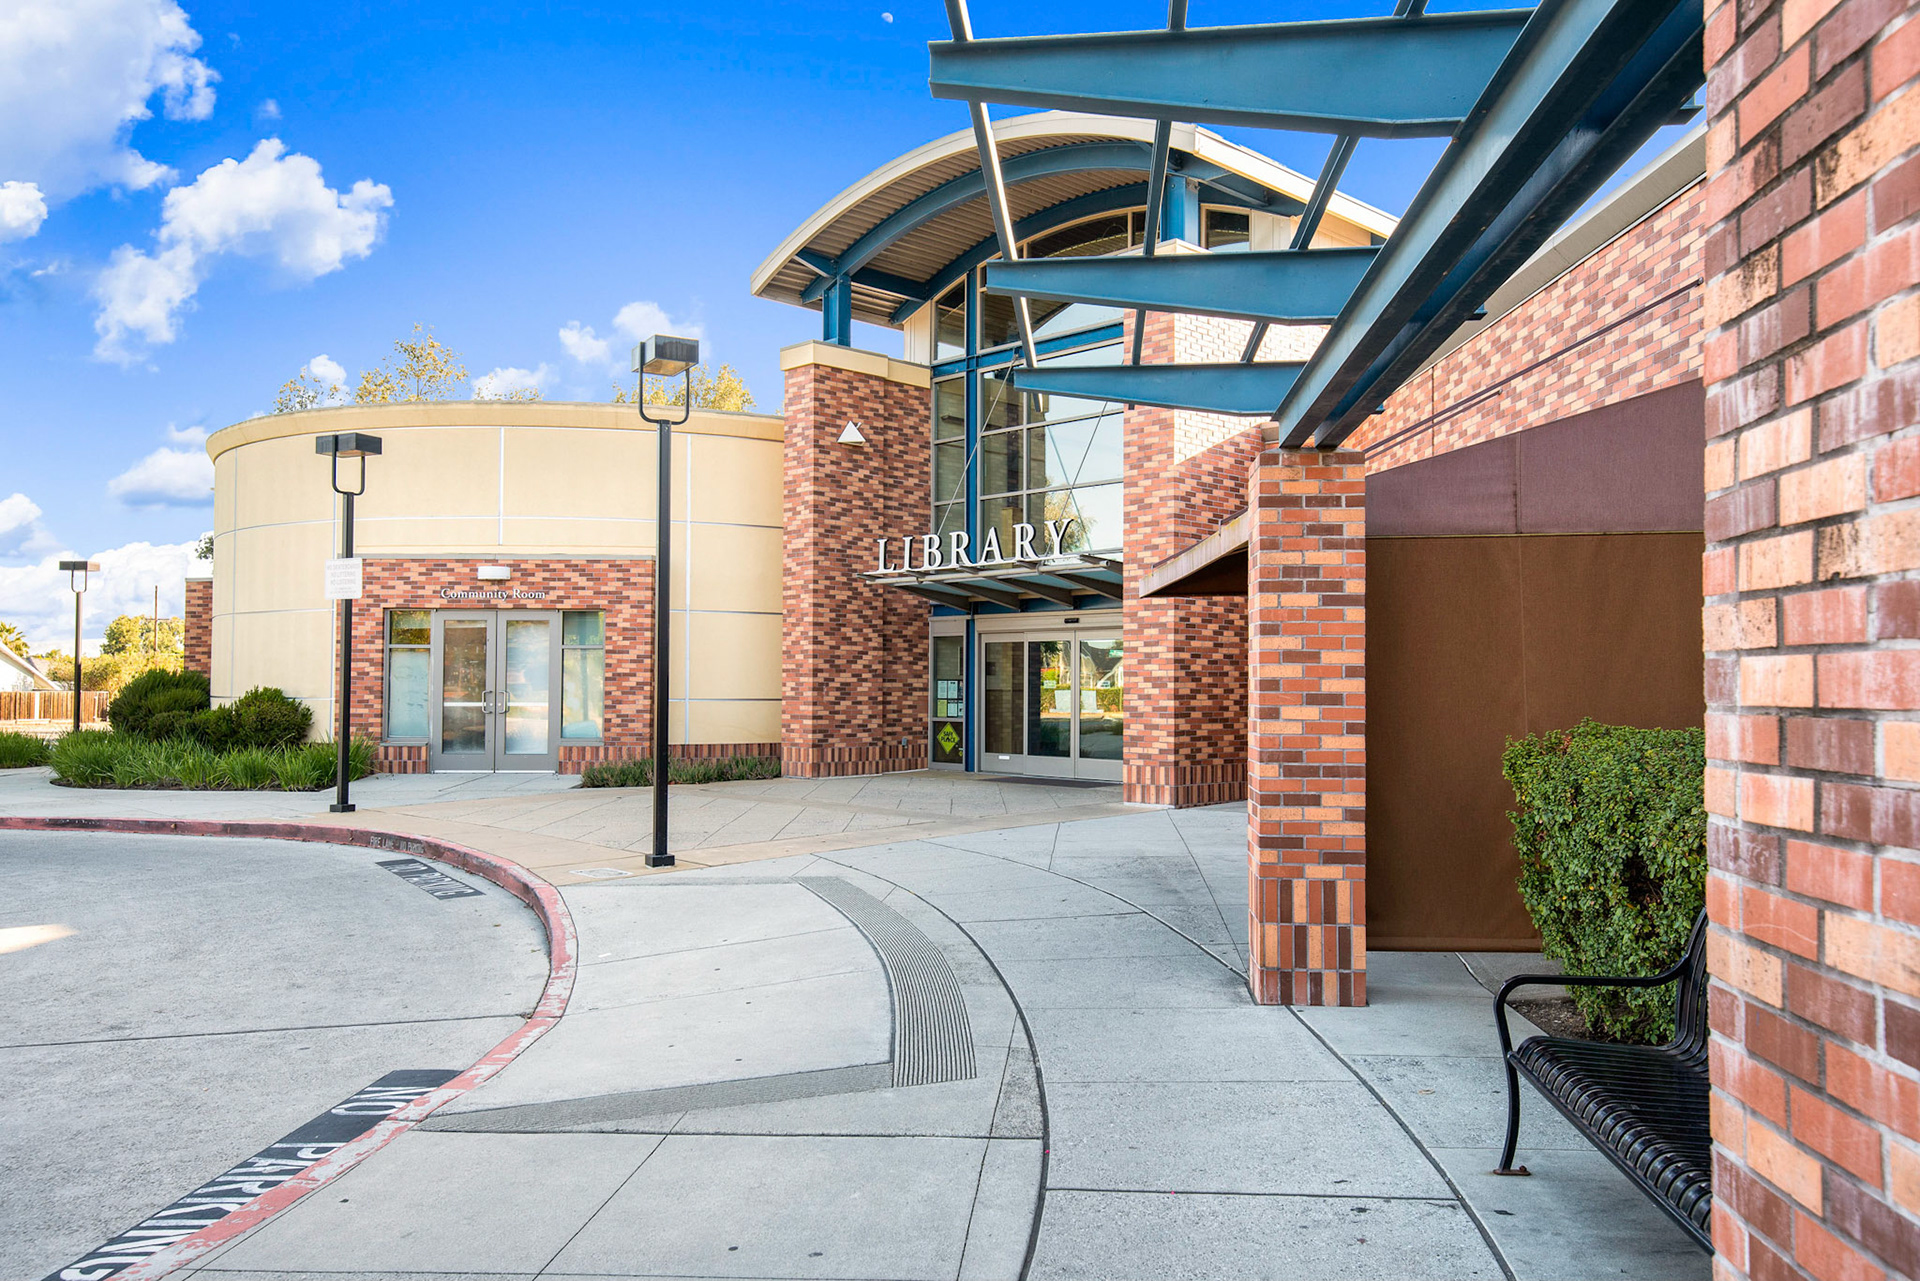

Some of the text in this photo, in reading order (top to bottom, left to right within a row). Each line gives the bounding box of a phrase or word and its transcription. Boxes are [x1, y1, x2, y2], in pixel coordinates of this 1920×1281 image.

[876, 518, 1074, 573] LIBRARY
[440, 588, 546, 601] Community Room
[60, 1086, 438, 1281] NO PARKING
